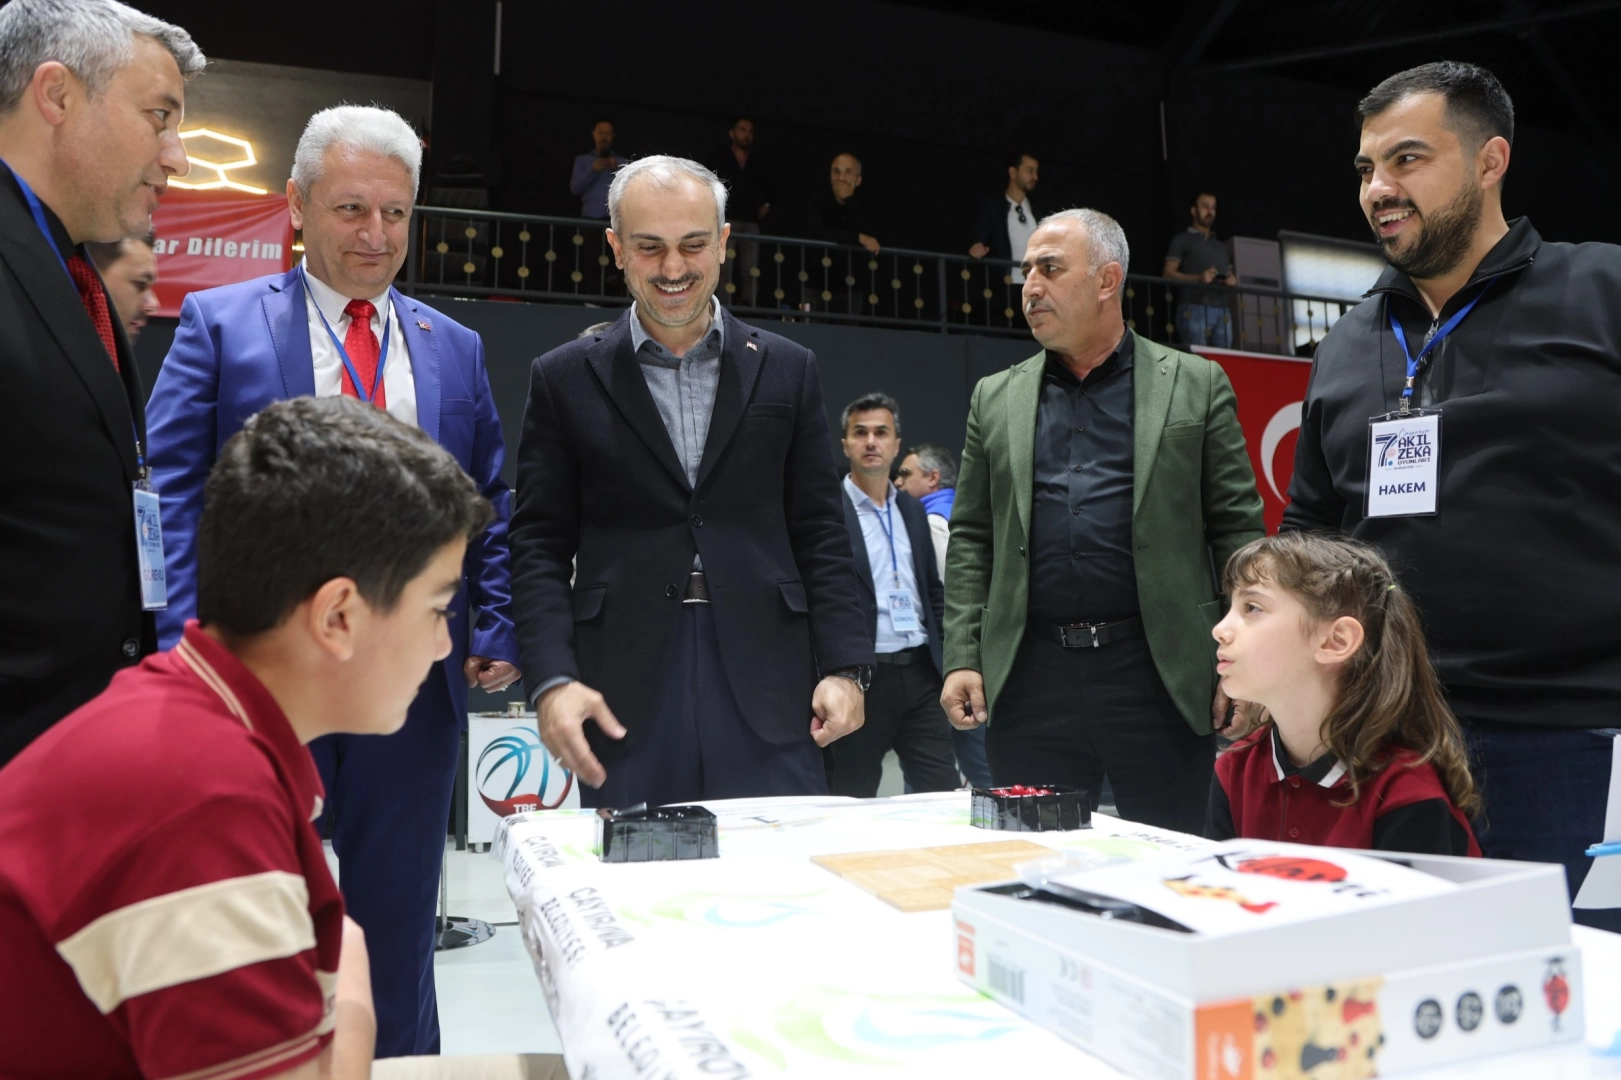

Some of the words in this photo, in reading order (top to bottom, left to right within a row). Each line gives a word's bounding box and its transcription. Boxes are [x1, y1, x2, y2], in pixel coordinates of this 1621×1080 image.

[186, 237, 282, 260] Dilerim
[1398, 434, 1431, 448] AKIL
[1398, 445, 1431, 460] ZEKA
[1378, 481, 1426, 496] HAKEM
